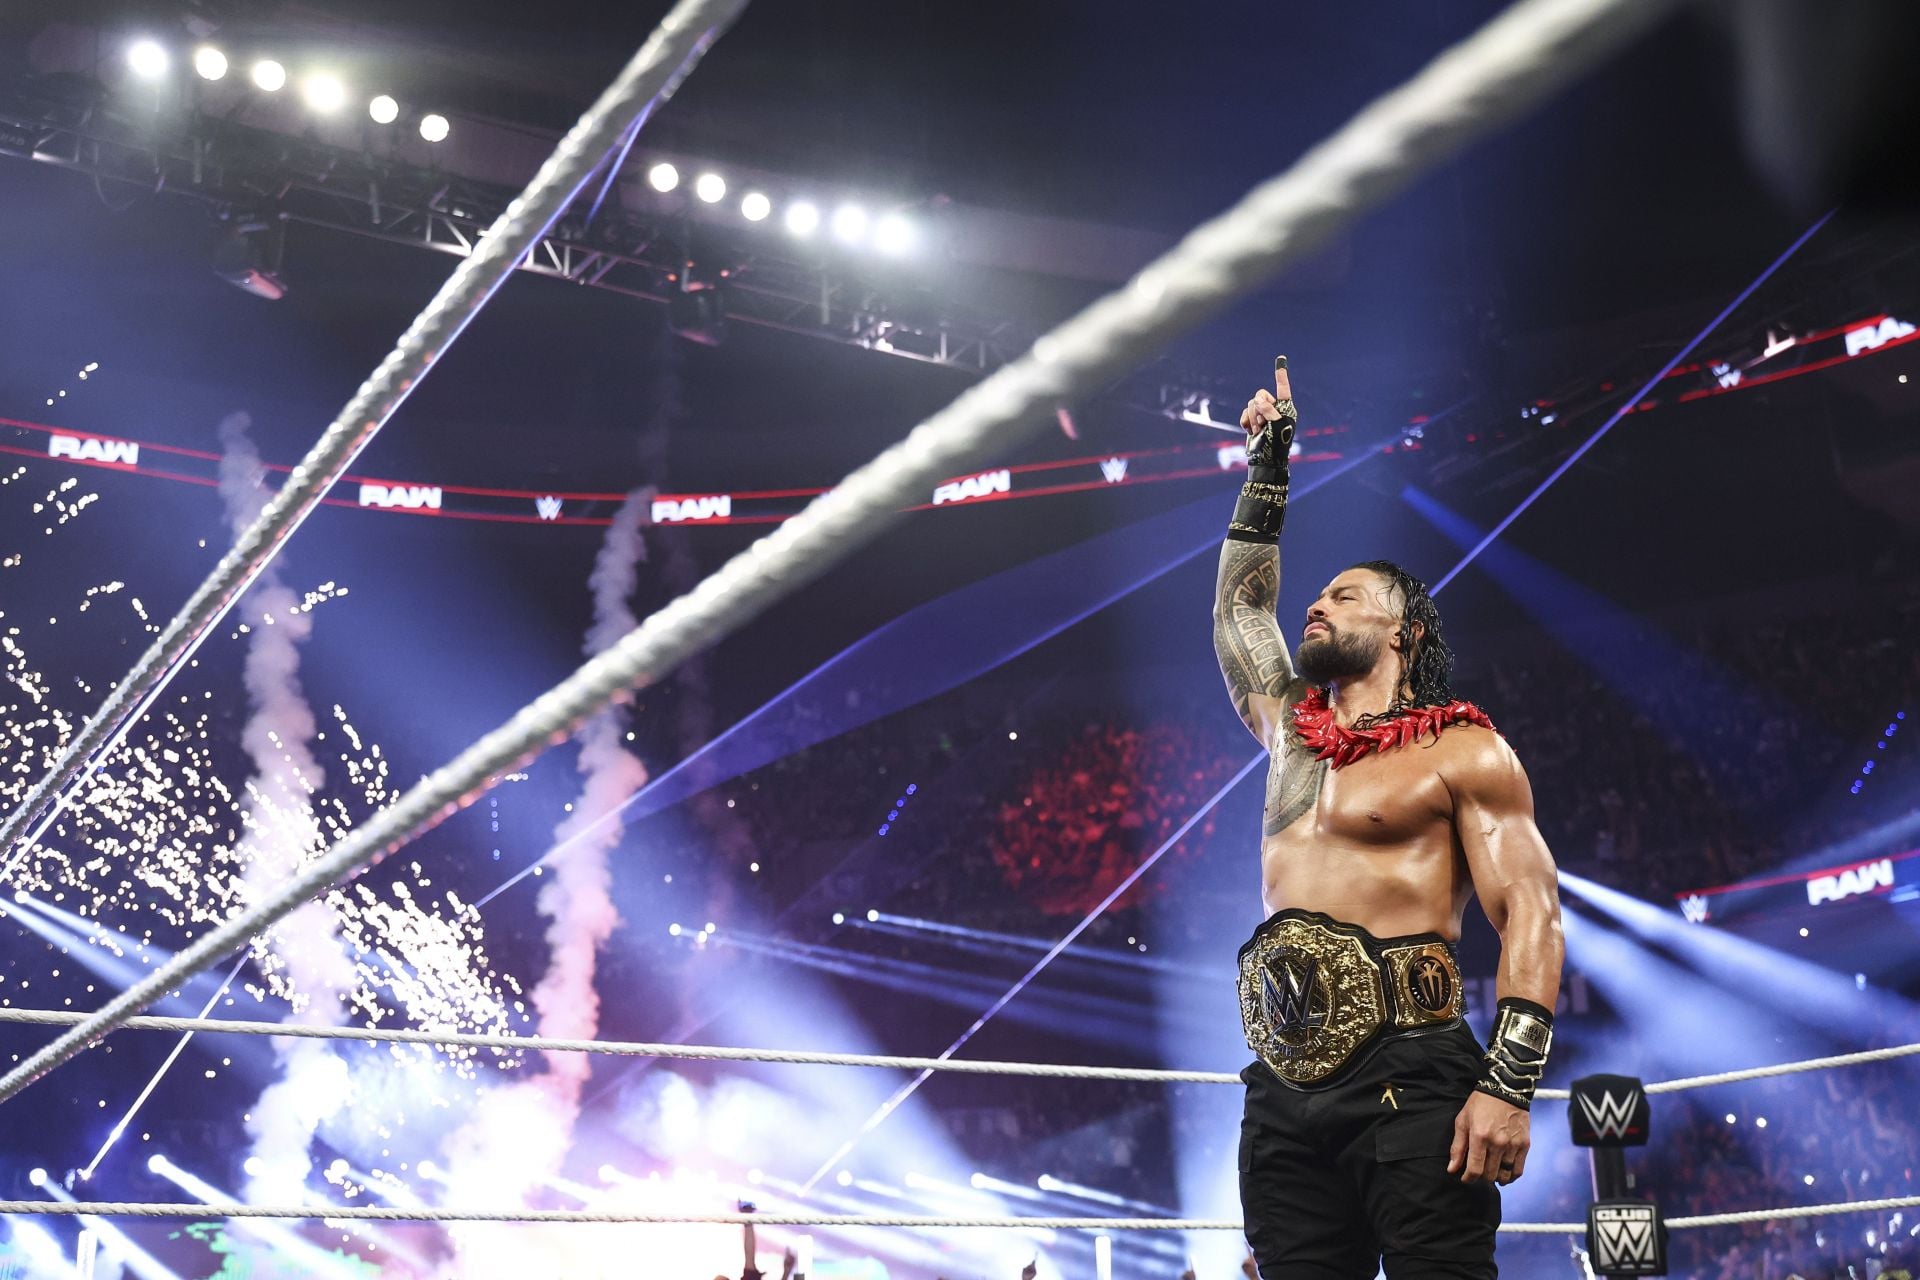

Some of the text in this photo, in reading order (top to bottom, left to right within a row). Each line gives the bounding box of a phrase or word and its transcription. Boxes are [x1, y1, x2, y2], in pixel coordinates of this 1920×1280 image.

[1845, 316, 1917, 356] RA
[48, 434, 140, 465] RAW
[358, 484, 442, 509] RAW
[932, 469, 1011, 505] RAW
[651, 495, 731, 523] RAW
[1806, 858, 1895, 906] RAW
[1596, 1209, 1651, 1221] CLUB
